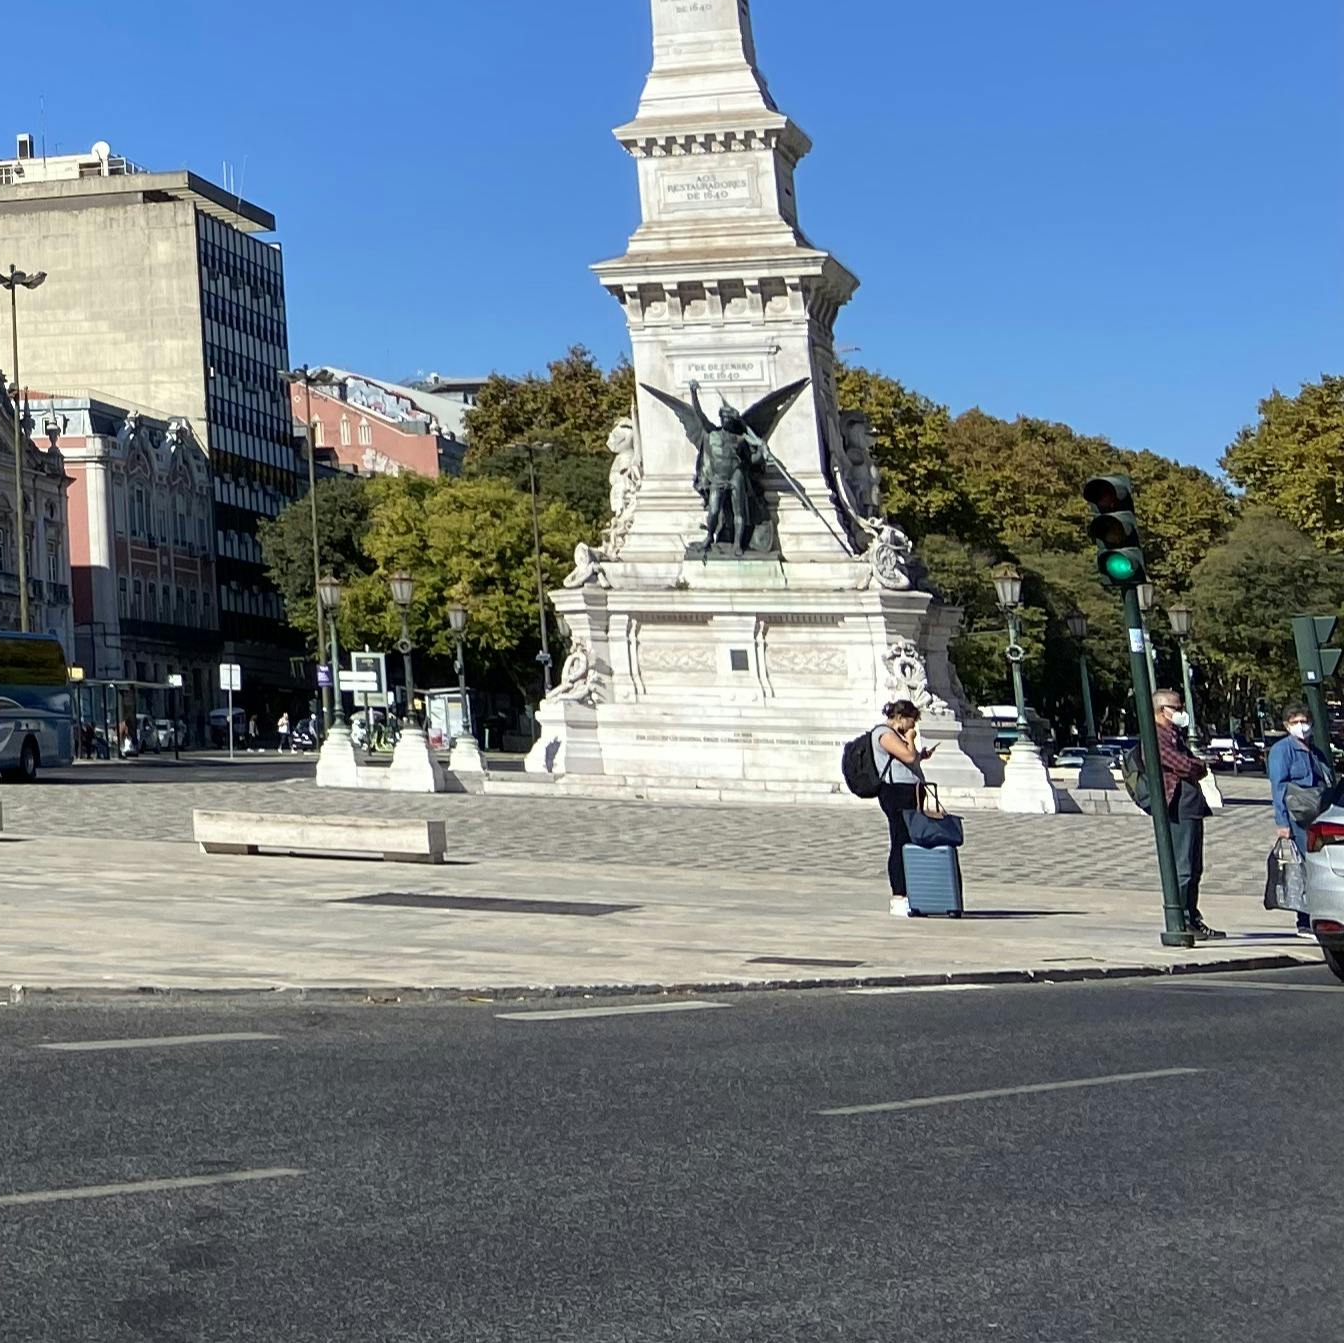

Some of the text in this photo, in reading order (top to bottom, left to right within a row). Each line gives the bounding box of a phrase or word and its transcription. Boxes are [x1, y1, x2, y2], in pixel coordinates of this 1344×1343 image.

[696, 174, 717, 183] AOS
[667, 179, 747, 193] RESTAURADORES
[687, 191, 701, 201] DE
